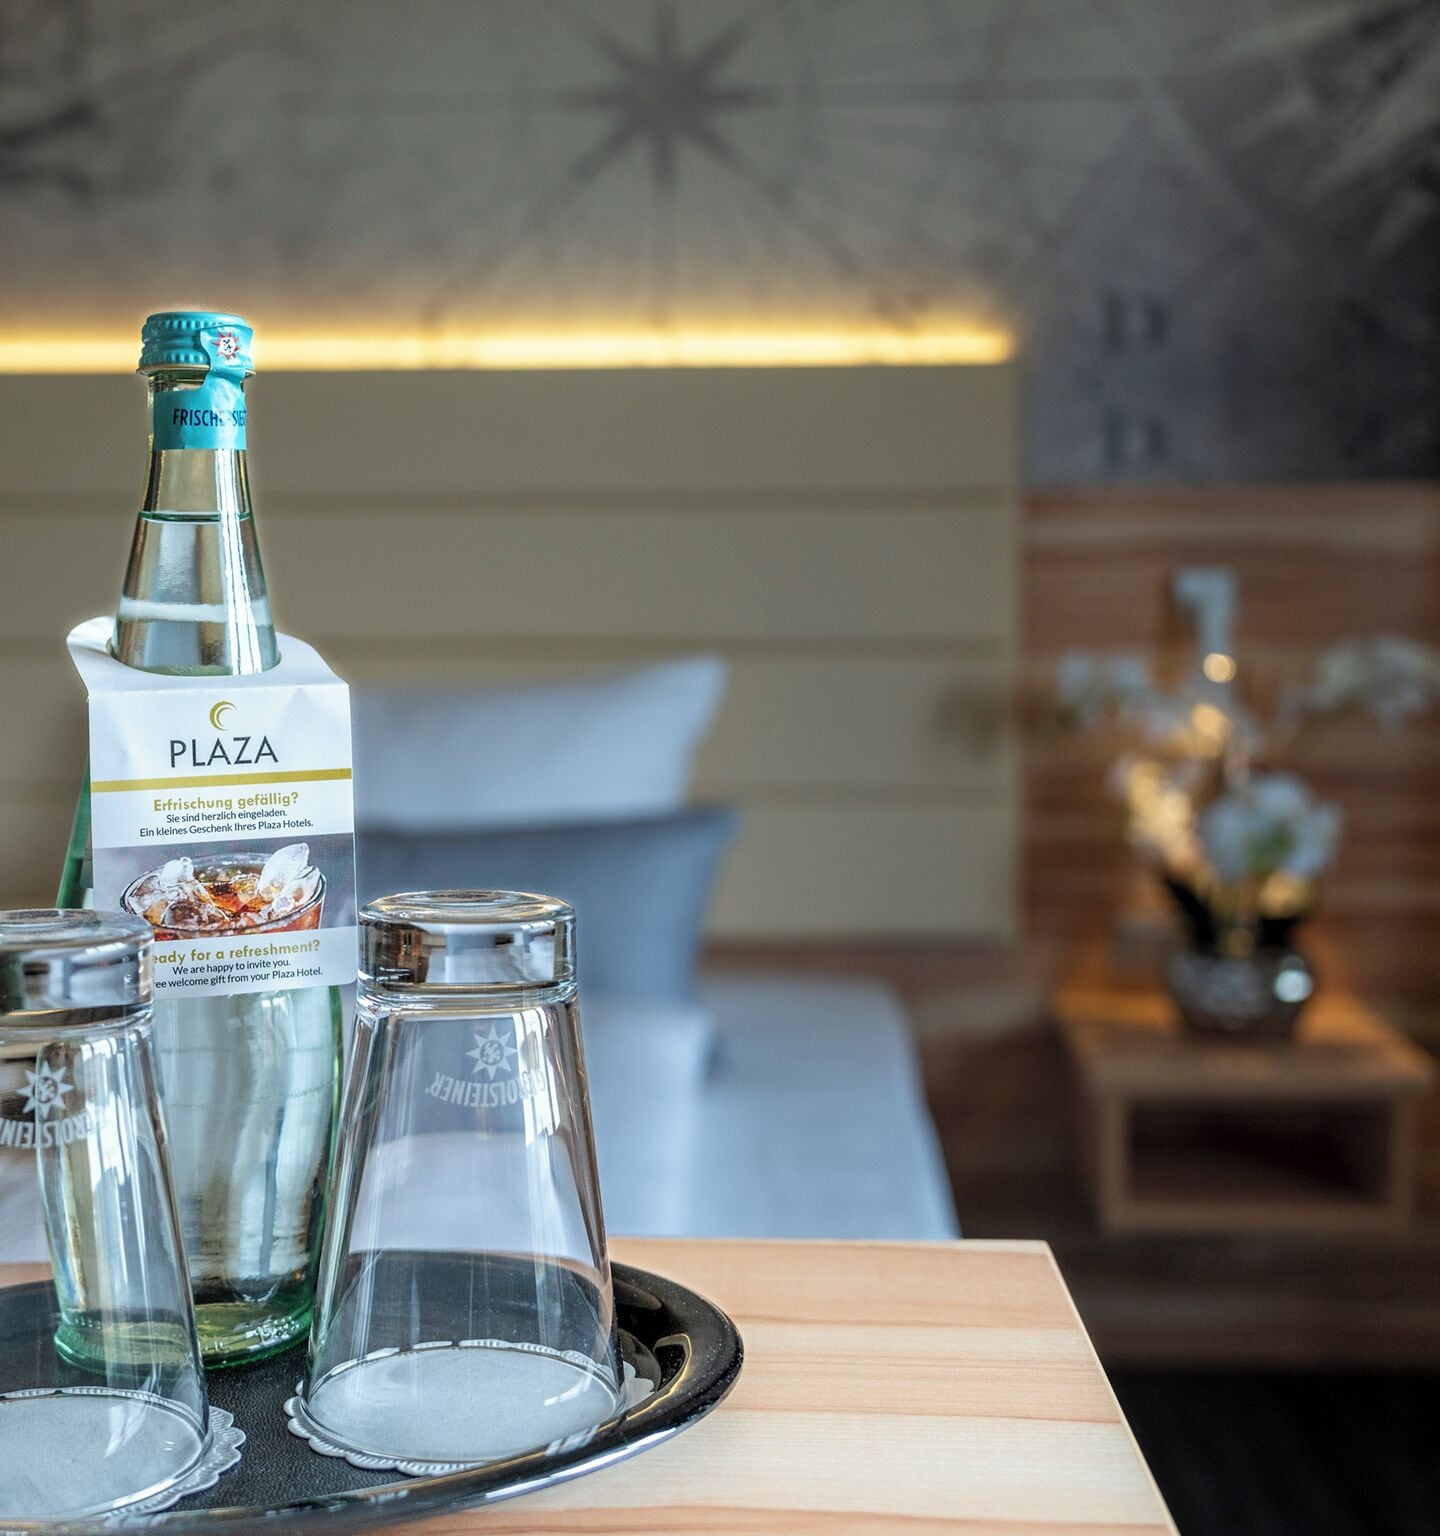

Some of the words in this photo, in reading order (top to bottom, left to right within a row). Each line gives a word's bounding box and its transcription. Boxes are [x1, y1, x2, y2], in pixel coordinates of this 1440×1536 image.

[170, 735, 279, 768] PLAZA
[153, 796, 233, 812] Erfrischung
[237, 791, 299, 810] gefällig?
[166, 814, 180, 824] Sie
[181, 812, 200, 823] sind
[201, 810, 237, 822] herzlich
[238, 808, 288, 821] eingeladen.
[139, 827, 155, 837] Ein
[156, 825, 188, 836] kleines
[189, 823, 233, 834] Geschenk
[234, 821, 257, 832] Ihres
[258, 820, 282, 830] Plaza
[283, 818, 314, 829] Hotels.
[153, 950, 186, 965] eady
[191, 949, 211, 962] for
[215, 951, 225, 960] a
[229, 939, 321, 959] refreshment?
[153, 979, 167, 989] ee
[169, 976, 209, 988] welcome
[210, 974, 226, 987] gift
[227, 972, 249, 983] from
[250, 972, 271, 984] your
[272, 969, 295, 980] Plaza
[296, 966, 323, 978] Hotel.
[172, 965, 188, 975] We
[190, 966, 205, 974] are
[206, 962, 234, 974] happy
[235, 962, 246, 971] to
[246, 959, 271, 970] invite
[272, 959, 291, 970] you.
